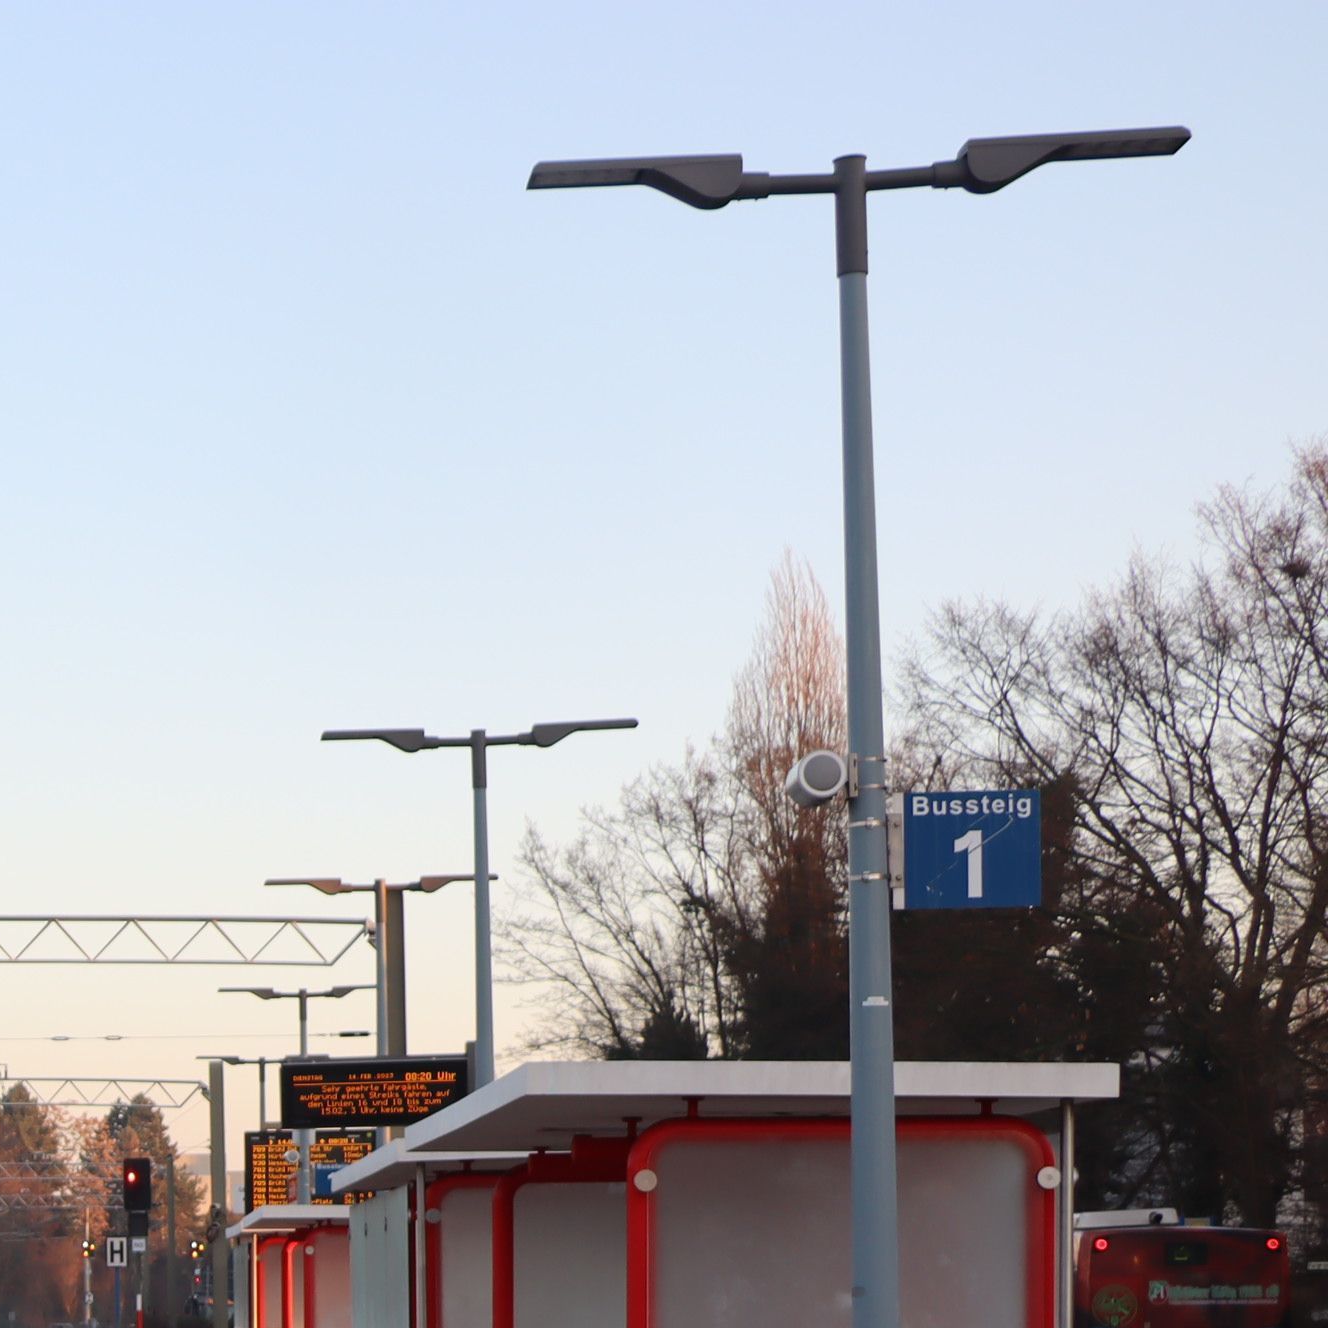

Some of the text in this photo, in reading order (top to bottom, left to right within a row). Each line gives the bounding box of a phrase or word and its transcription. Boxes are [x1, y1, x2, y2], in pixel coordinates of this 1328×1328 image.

[912, 793, 1032, 819] Bussteig
[953, 829, 983, 899] 1
[437, 1071, 456, 1080] Uhr
[345, 1084, 379, 1093] geehrte
[299, 1088, 450, 1102] aufgrund eines Streiks fahren auf
[372, 1098, 388, 1106] und
[406, 1097, 420, 1105] bis
[424, 1097, 442, 1105] zum
[380, 1105, 404, 1113] keine
[110, 1240, 124, 1263] H
